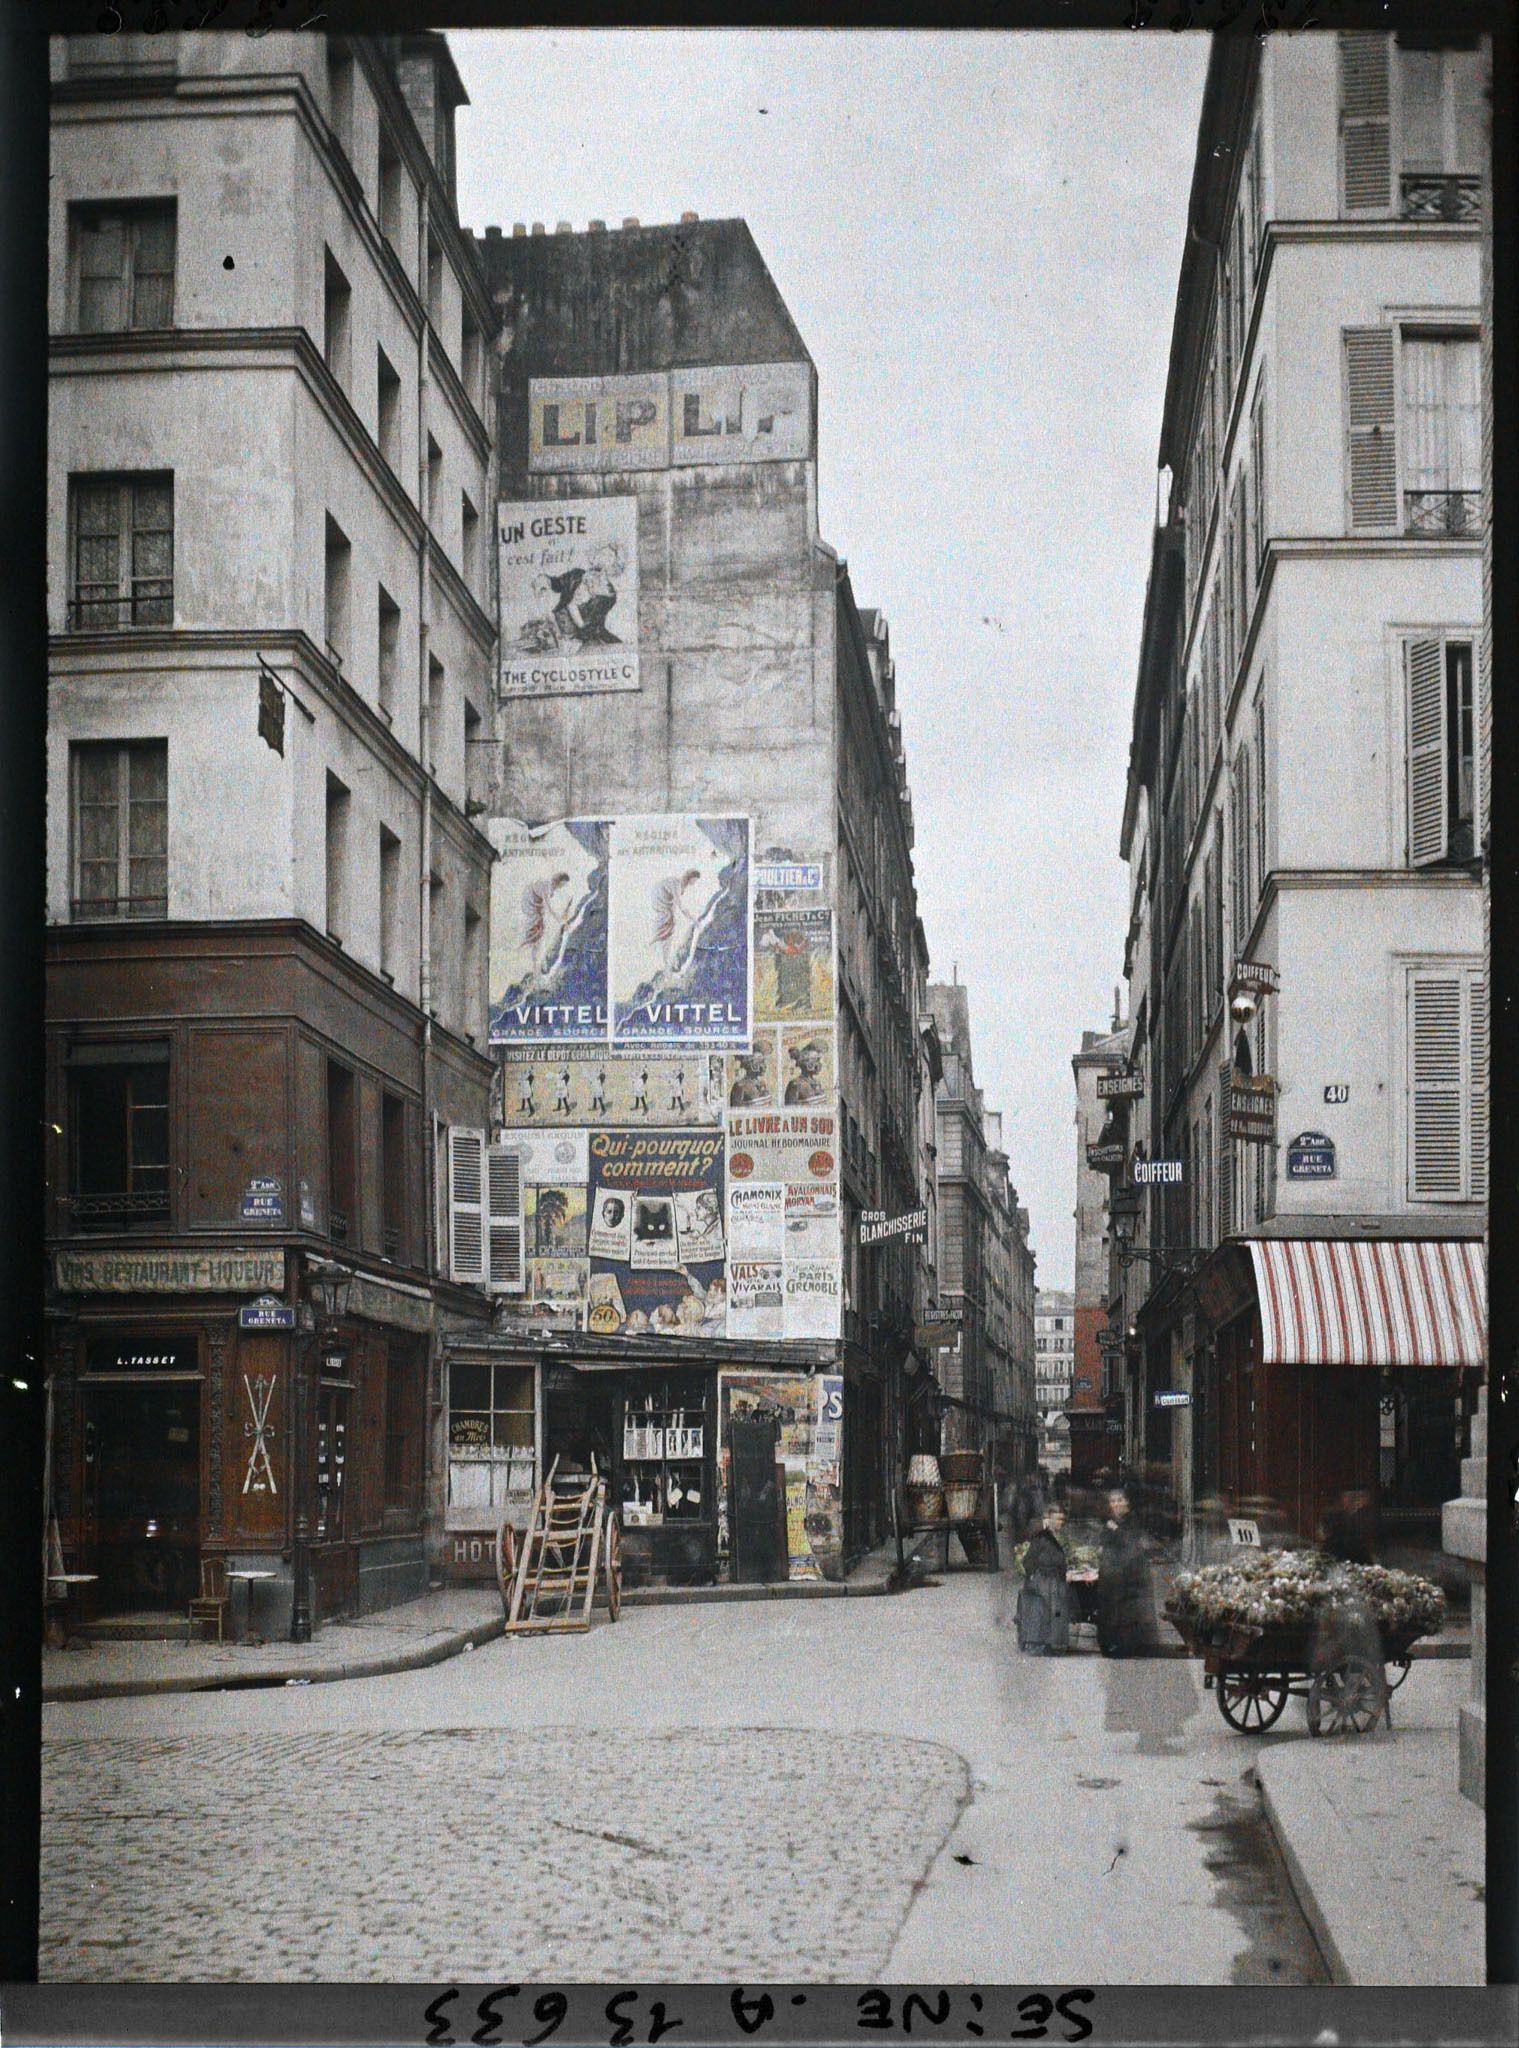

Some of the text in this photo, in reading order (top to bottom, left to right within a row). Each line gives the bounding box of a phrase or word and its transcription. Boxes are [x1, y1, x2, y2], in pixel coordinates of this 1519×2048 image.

[543, 401, 657, 446] LIP
[501, 516, 586, 544] UN GESTE
[503, 671, 527, 684] THE
[531, 668, 618, 683] CYCLOSTYLE
[516, 1005, 608, 1025] VITTEL
[644, 1003, 742, 1023] VITTEL
[622, 1026, 740, 1036] GRANDE SOURCE
[537, 1051, 545, 1061] LE
[1098, 1077, 1143, 1096] ENSEIGNES
[1326, 1086, 1347, 1102] 40
[1231, 1092, 1274, 1116] ENSEIGNES
[729, 1119, 742, 1137] LE
[745, 1114, 782, 1135] LIVRE
[791, 1116, 807, 1133] UN
[811, 1116, 834, 1135] SOU
[731, 1138, 832, 1149] JOURNAL HEBDOMADAIRE
[1302, 1155, 1323, 1164] RUE
[1135, 1162, 1183, 1183] COIFFEUR
[1292, 1165, 1332, 1173] GRENETA
[253, 1198, 273, 1206] RUE
[730, 1190, 782, 1210] CHAMONIX
[243, 1208, 282, 1217] GRENETA
[861, 1210, 886, 1222] GROS
[860, 1209, 927, 1244] BLANCHISSERIE
[904, 1232, 924, 1244] FIN
[730, 1264, 758, 1281] VALS
[786, 1279, 838, 1296] GRENOBLE
[248, 1317, 287, 1325] GRENETA
